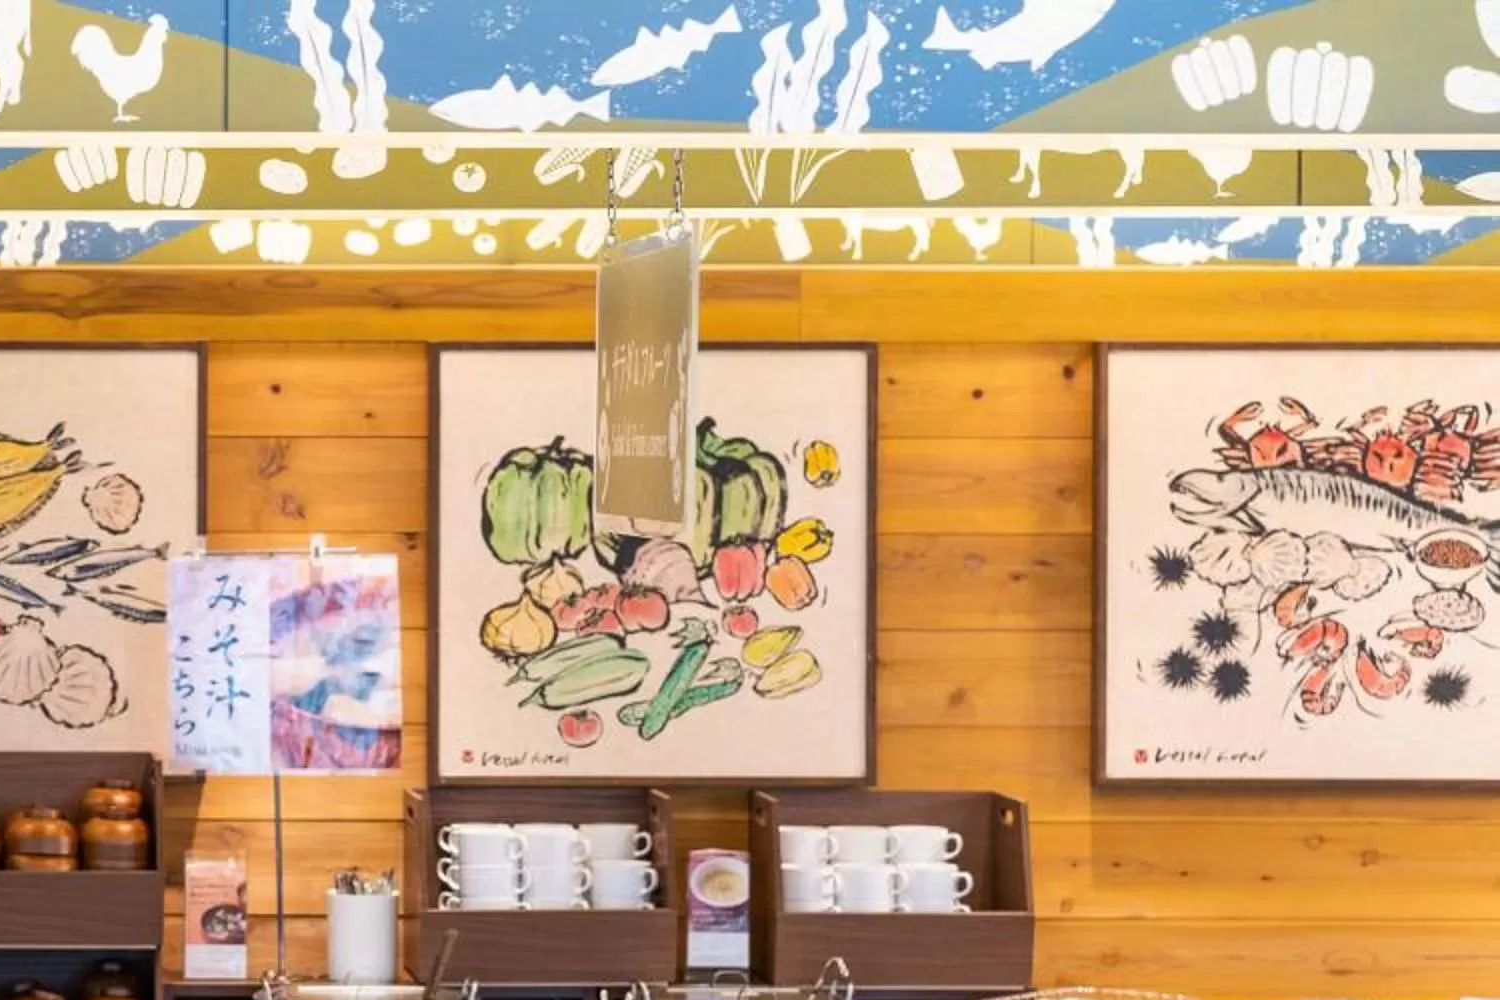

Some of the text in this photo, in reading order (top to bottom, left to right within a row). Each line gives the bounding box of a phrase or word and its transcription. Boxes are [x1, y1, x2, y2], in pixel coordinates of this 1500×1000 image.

[173, 635, 195, 736] こちら
[206, 574, 250, 719] みそ汁
